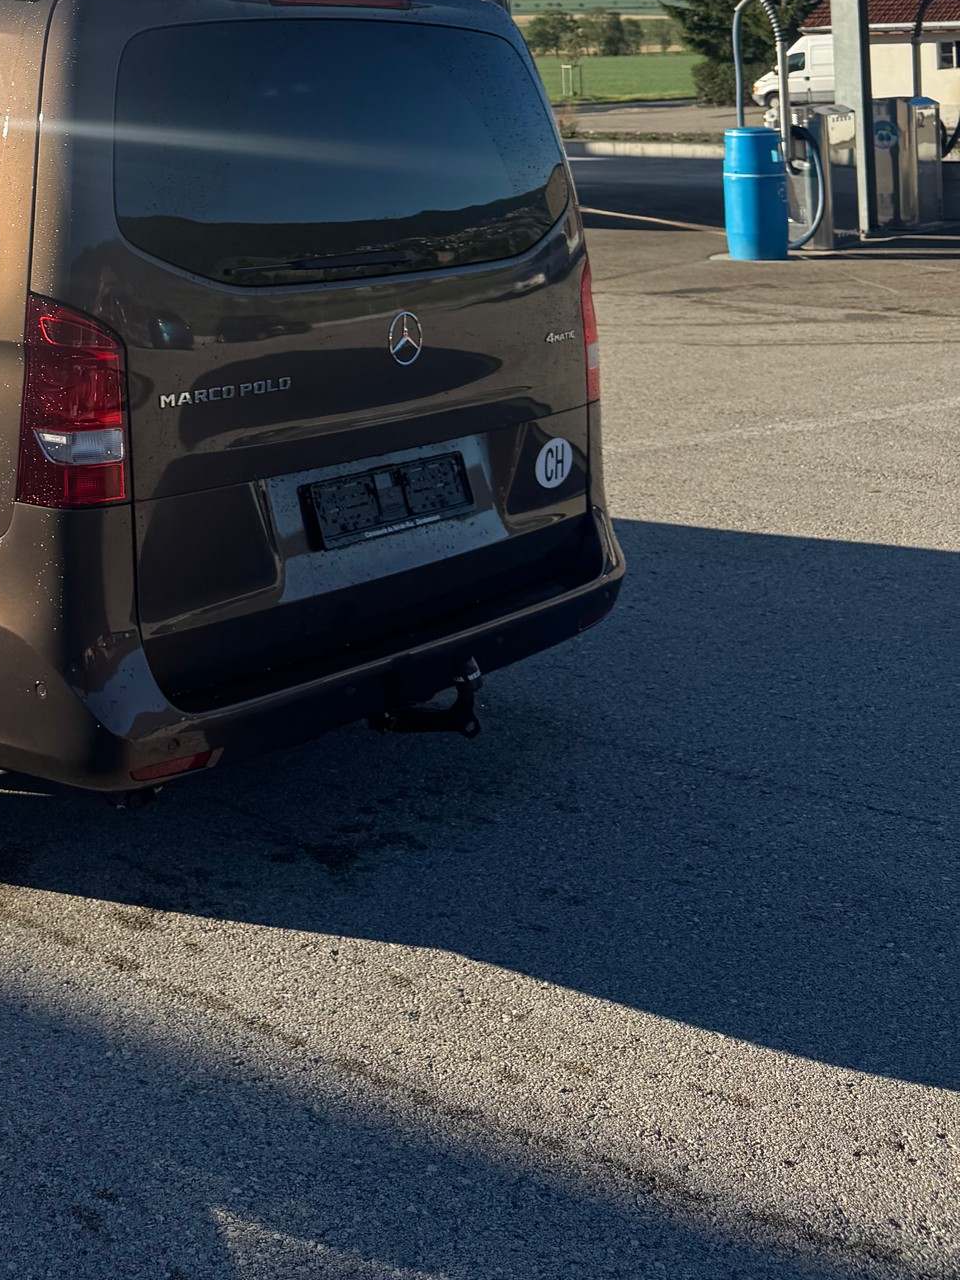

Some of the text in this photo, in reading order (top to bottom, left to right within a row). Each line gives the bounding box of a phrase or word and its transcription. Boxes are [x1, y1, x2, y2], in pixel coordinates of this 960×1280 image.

[546, 330, 576, 343] 4MATIC
[159, 376, 292, 408] MARCO POLO
[544, 443, 564, 482] CH
